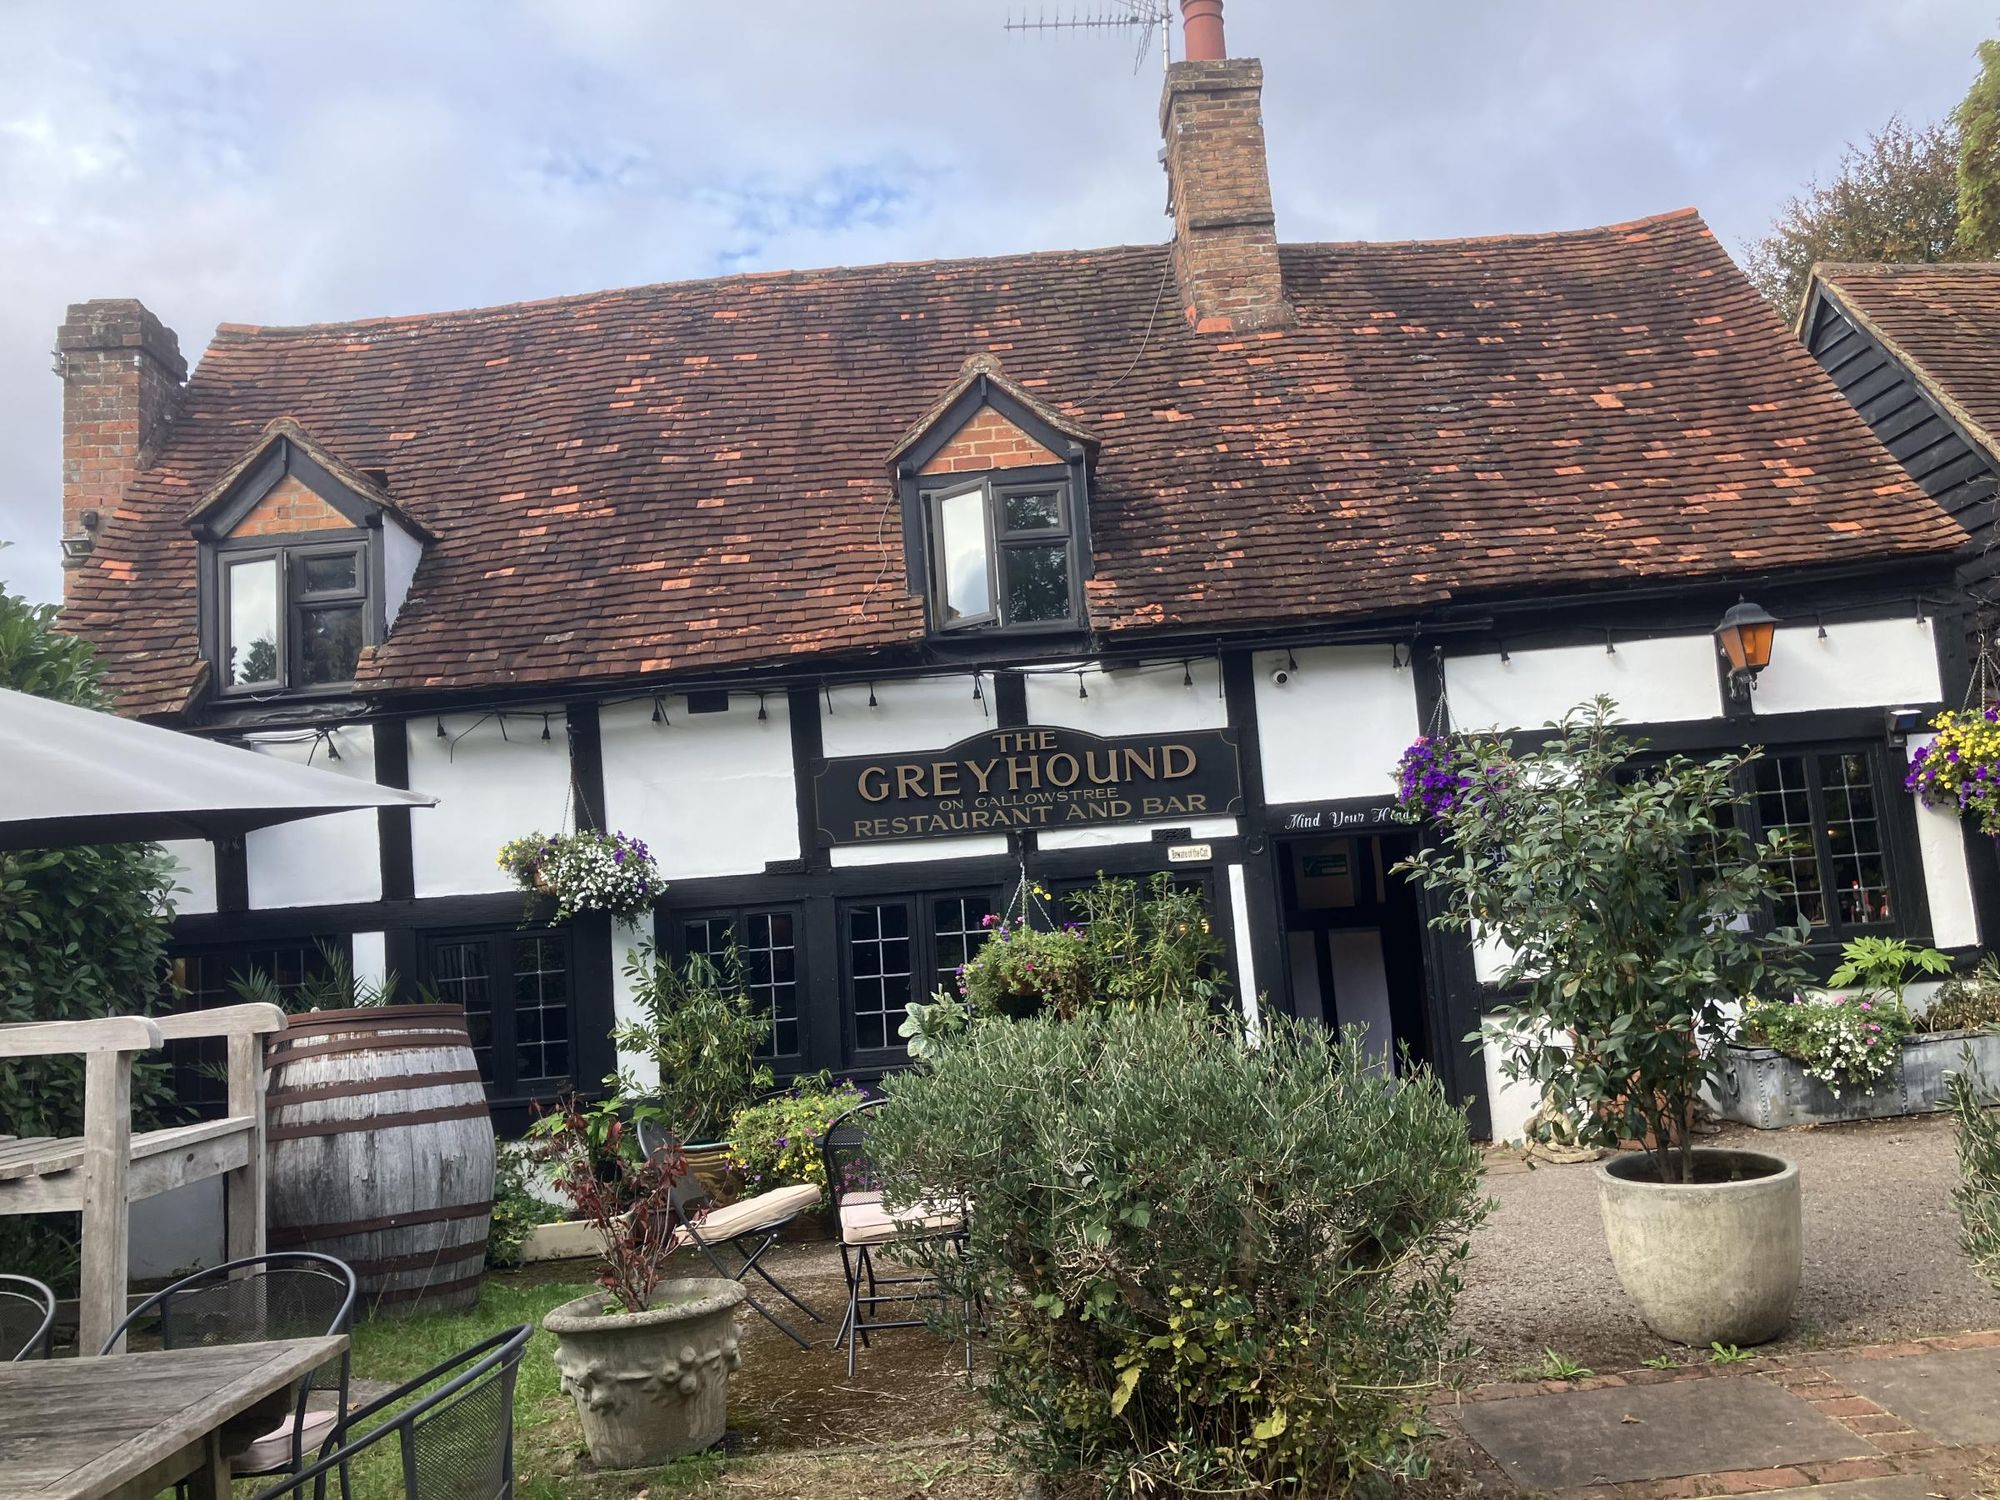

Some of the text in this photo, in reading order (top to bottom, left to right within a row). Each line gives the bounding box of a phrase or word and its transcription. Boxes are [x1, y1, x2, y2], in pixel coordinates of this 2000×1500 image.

[991, 730, 1058, 753] THE
[857, 745, 1197, 802] GREYHOUND
[939, 787, 1119, 811] ON GALLOWSTREE
[854, 794, 1207, 837] RESTAURANT AND BAR
[1285, 812, 1321, 831] Mind
[1328, 811, 1366, 829] Your
